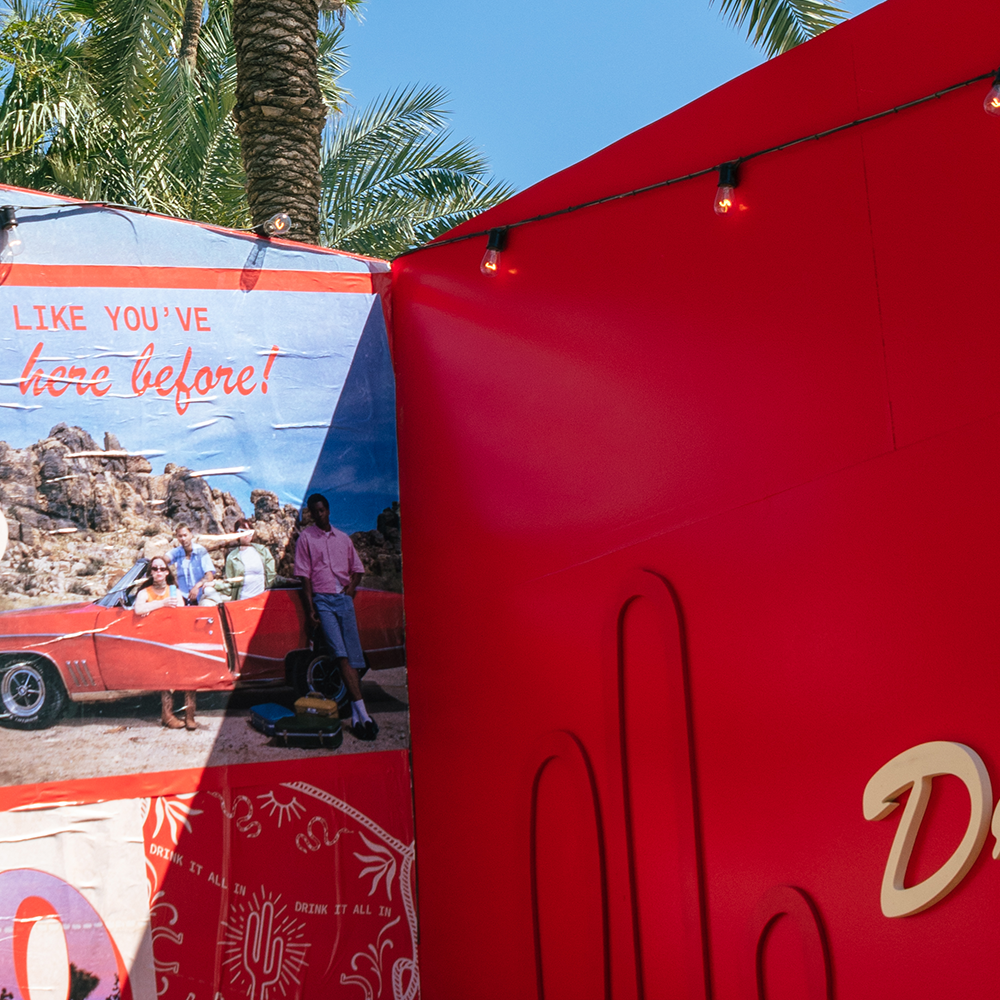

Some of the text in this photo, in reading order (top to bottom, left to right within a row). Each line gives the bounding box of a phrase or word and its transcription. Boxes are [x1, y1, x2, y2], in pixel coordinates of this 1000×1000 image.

[13, 304, 88, 332] LIKE
[104, 305, 212, 332] YOU'VE
[19, 341, 112, 398] here
[131, 342, 280, 416] before!
[862, 740, 1000, 918] D
[149, 843, 247, 897] DRINK IT ALL IN
[294, 901, 392, 918] DRINK IT ALL IN
